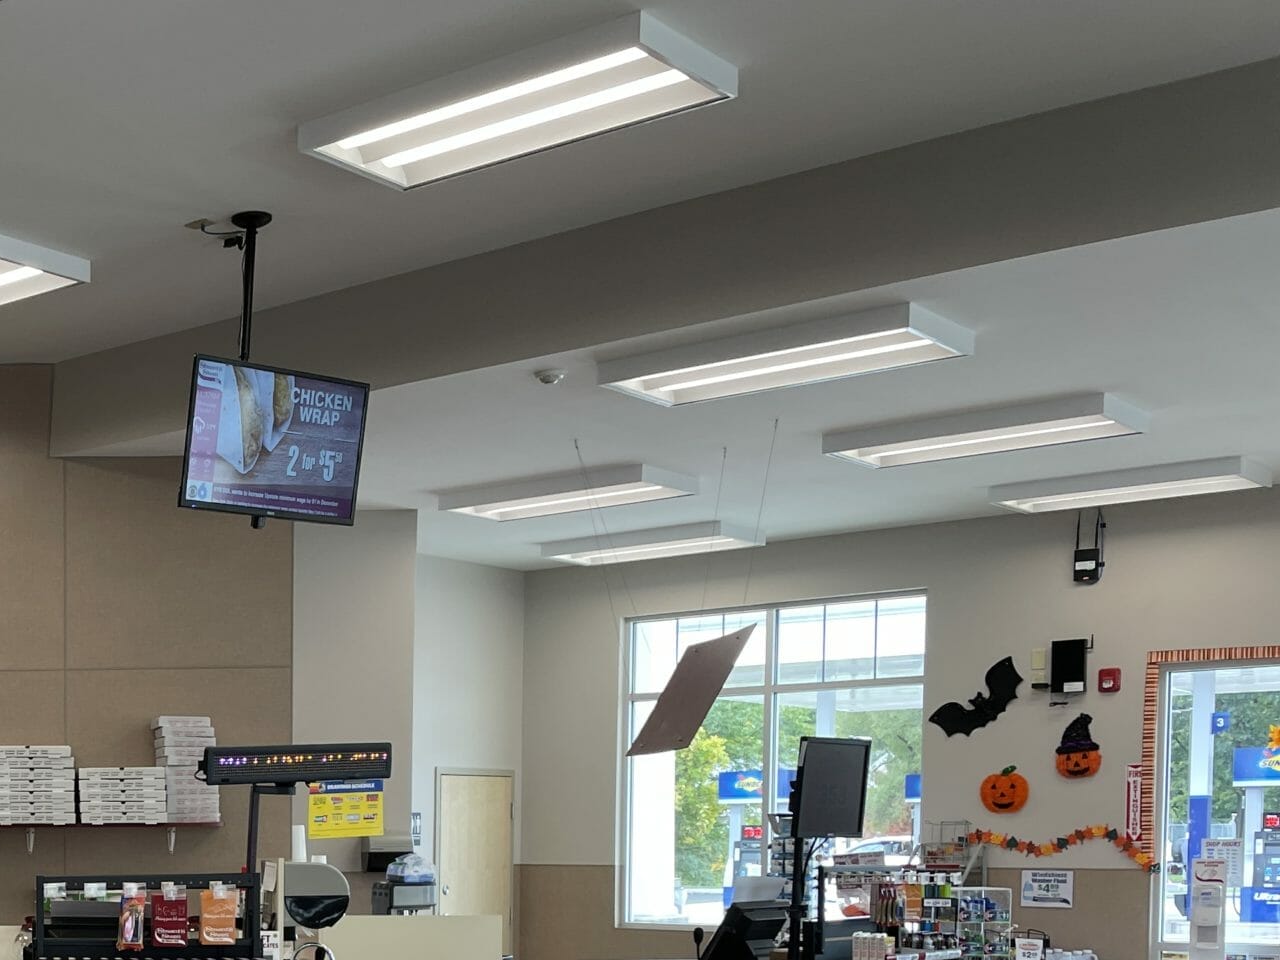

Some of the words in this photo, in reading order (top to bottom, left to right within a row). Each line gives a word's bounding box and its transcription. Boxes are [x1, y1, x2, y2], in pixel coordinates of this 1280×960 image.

[291, 387, 353, 411] CHICKEN
[299, 406, 340, 426] WRAP
[287, 445, 299, 477] 2
[302, 455, 315, 471] for
[1216, 717, 1225, 727] 3
